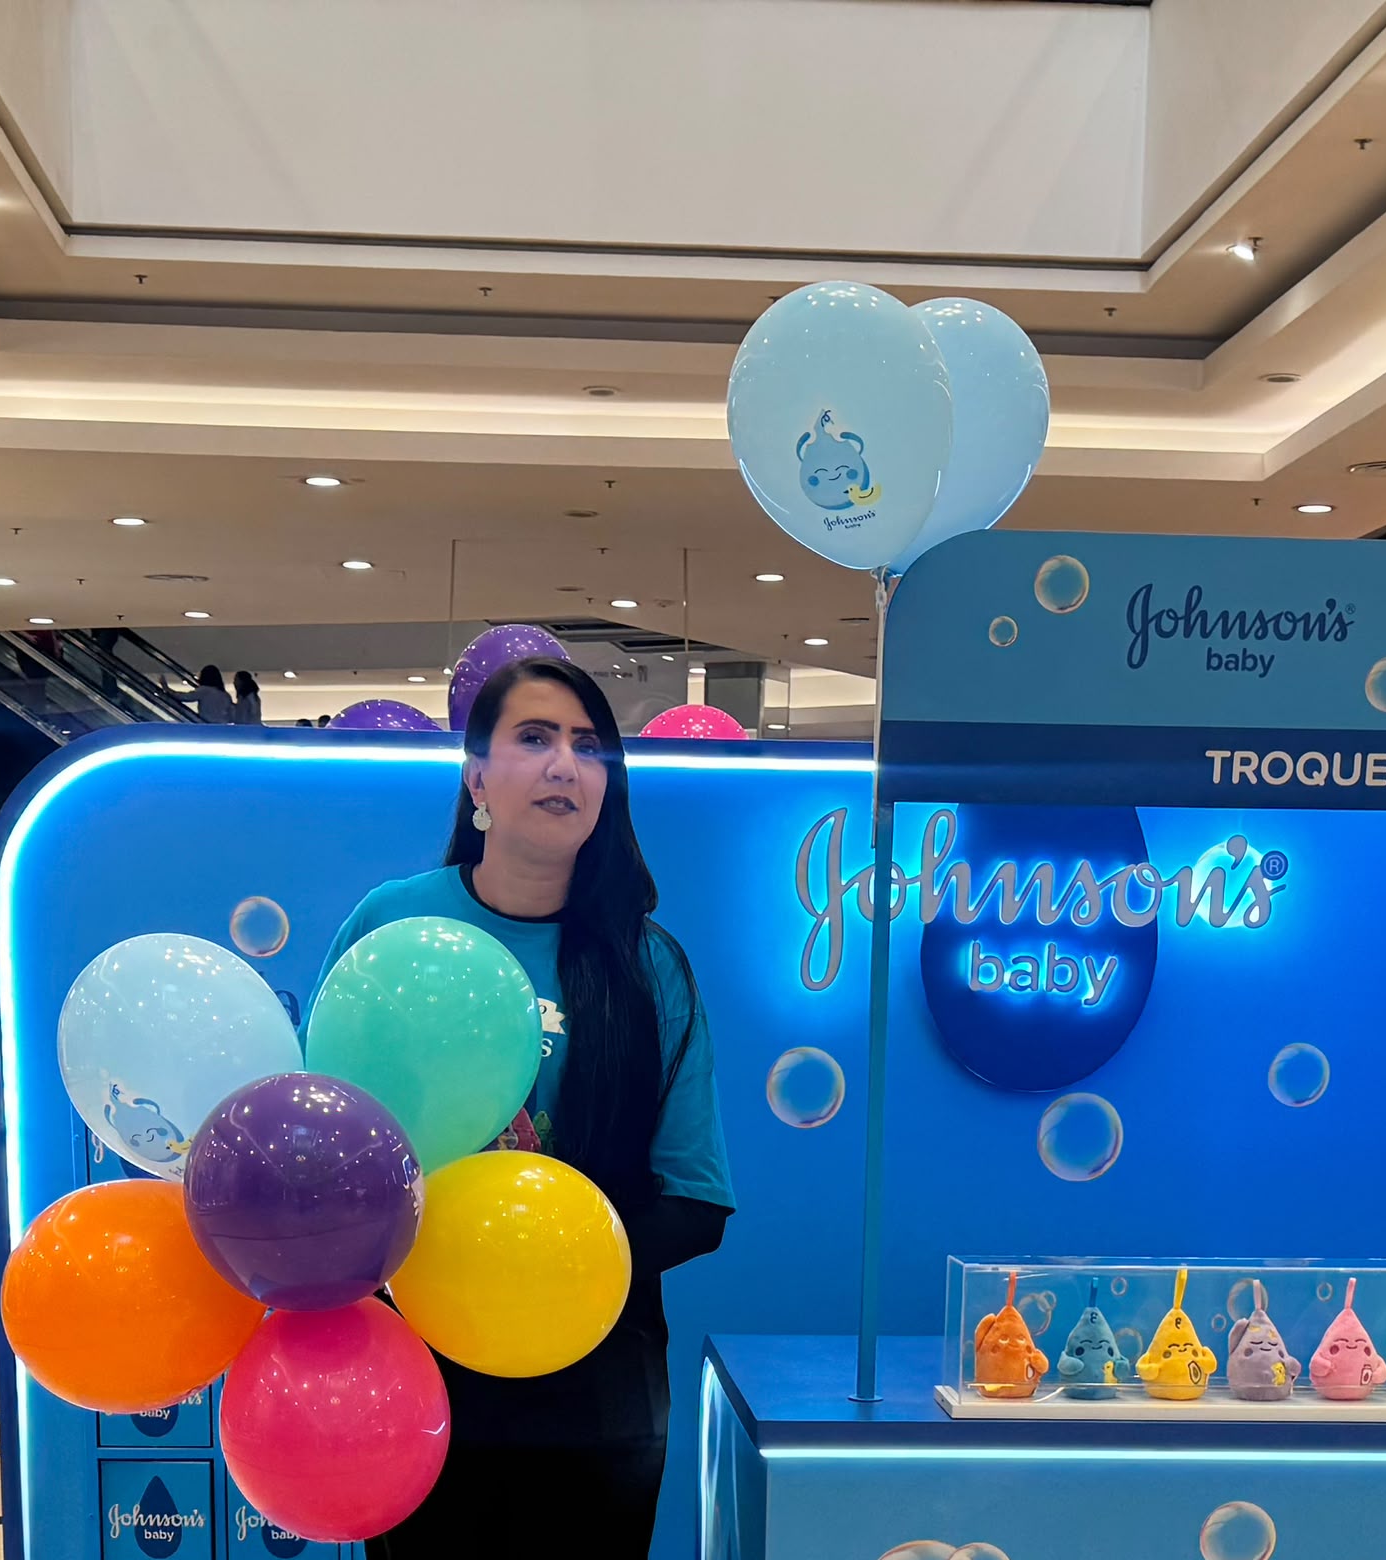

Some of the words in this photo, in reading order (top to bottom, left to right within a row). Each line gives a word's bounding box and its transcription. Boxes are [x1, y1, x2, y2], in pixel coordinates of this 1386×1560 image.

[1206, 647, 1275, 678] baby
[969, 941, 1117, 1005] baby
[108, 1504, 206, 1538] Johnson's
[144, 1529, 174, 1542] baby
